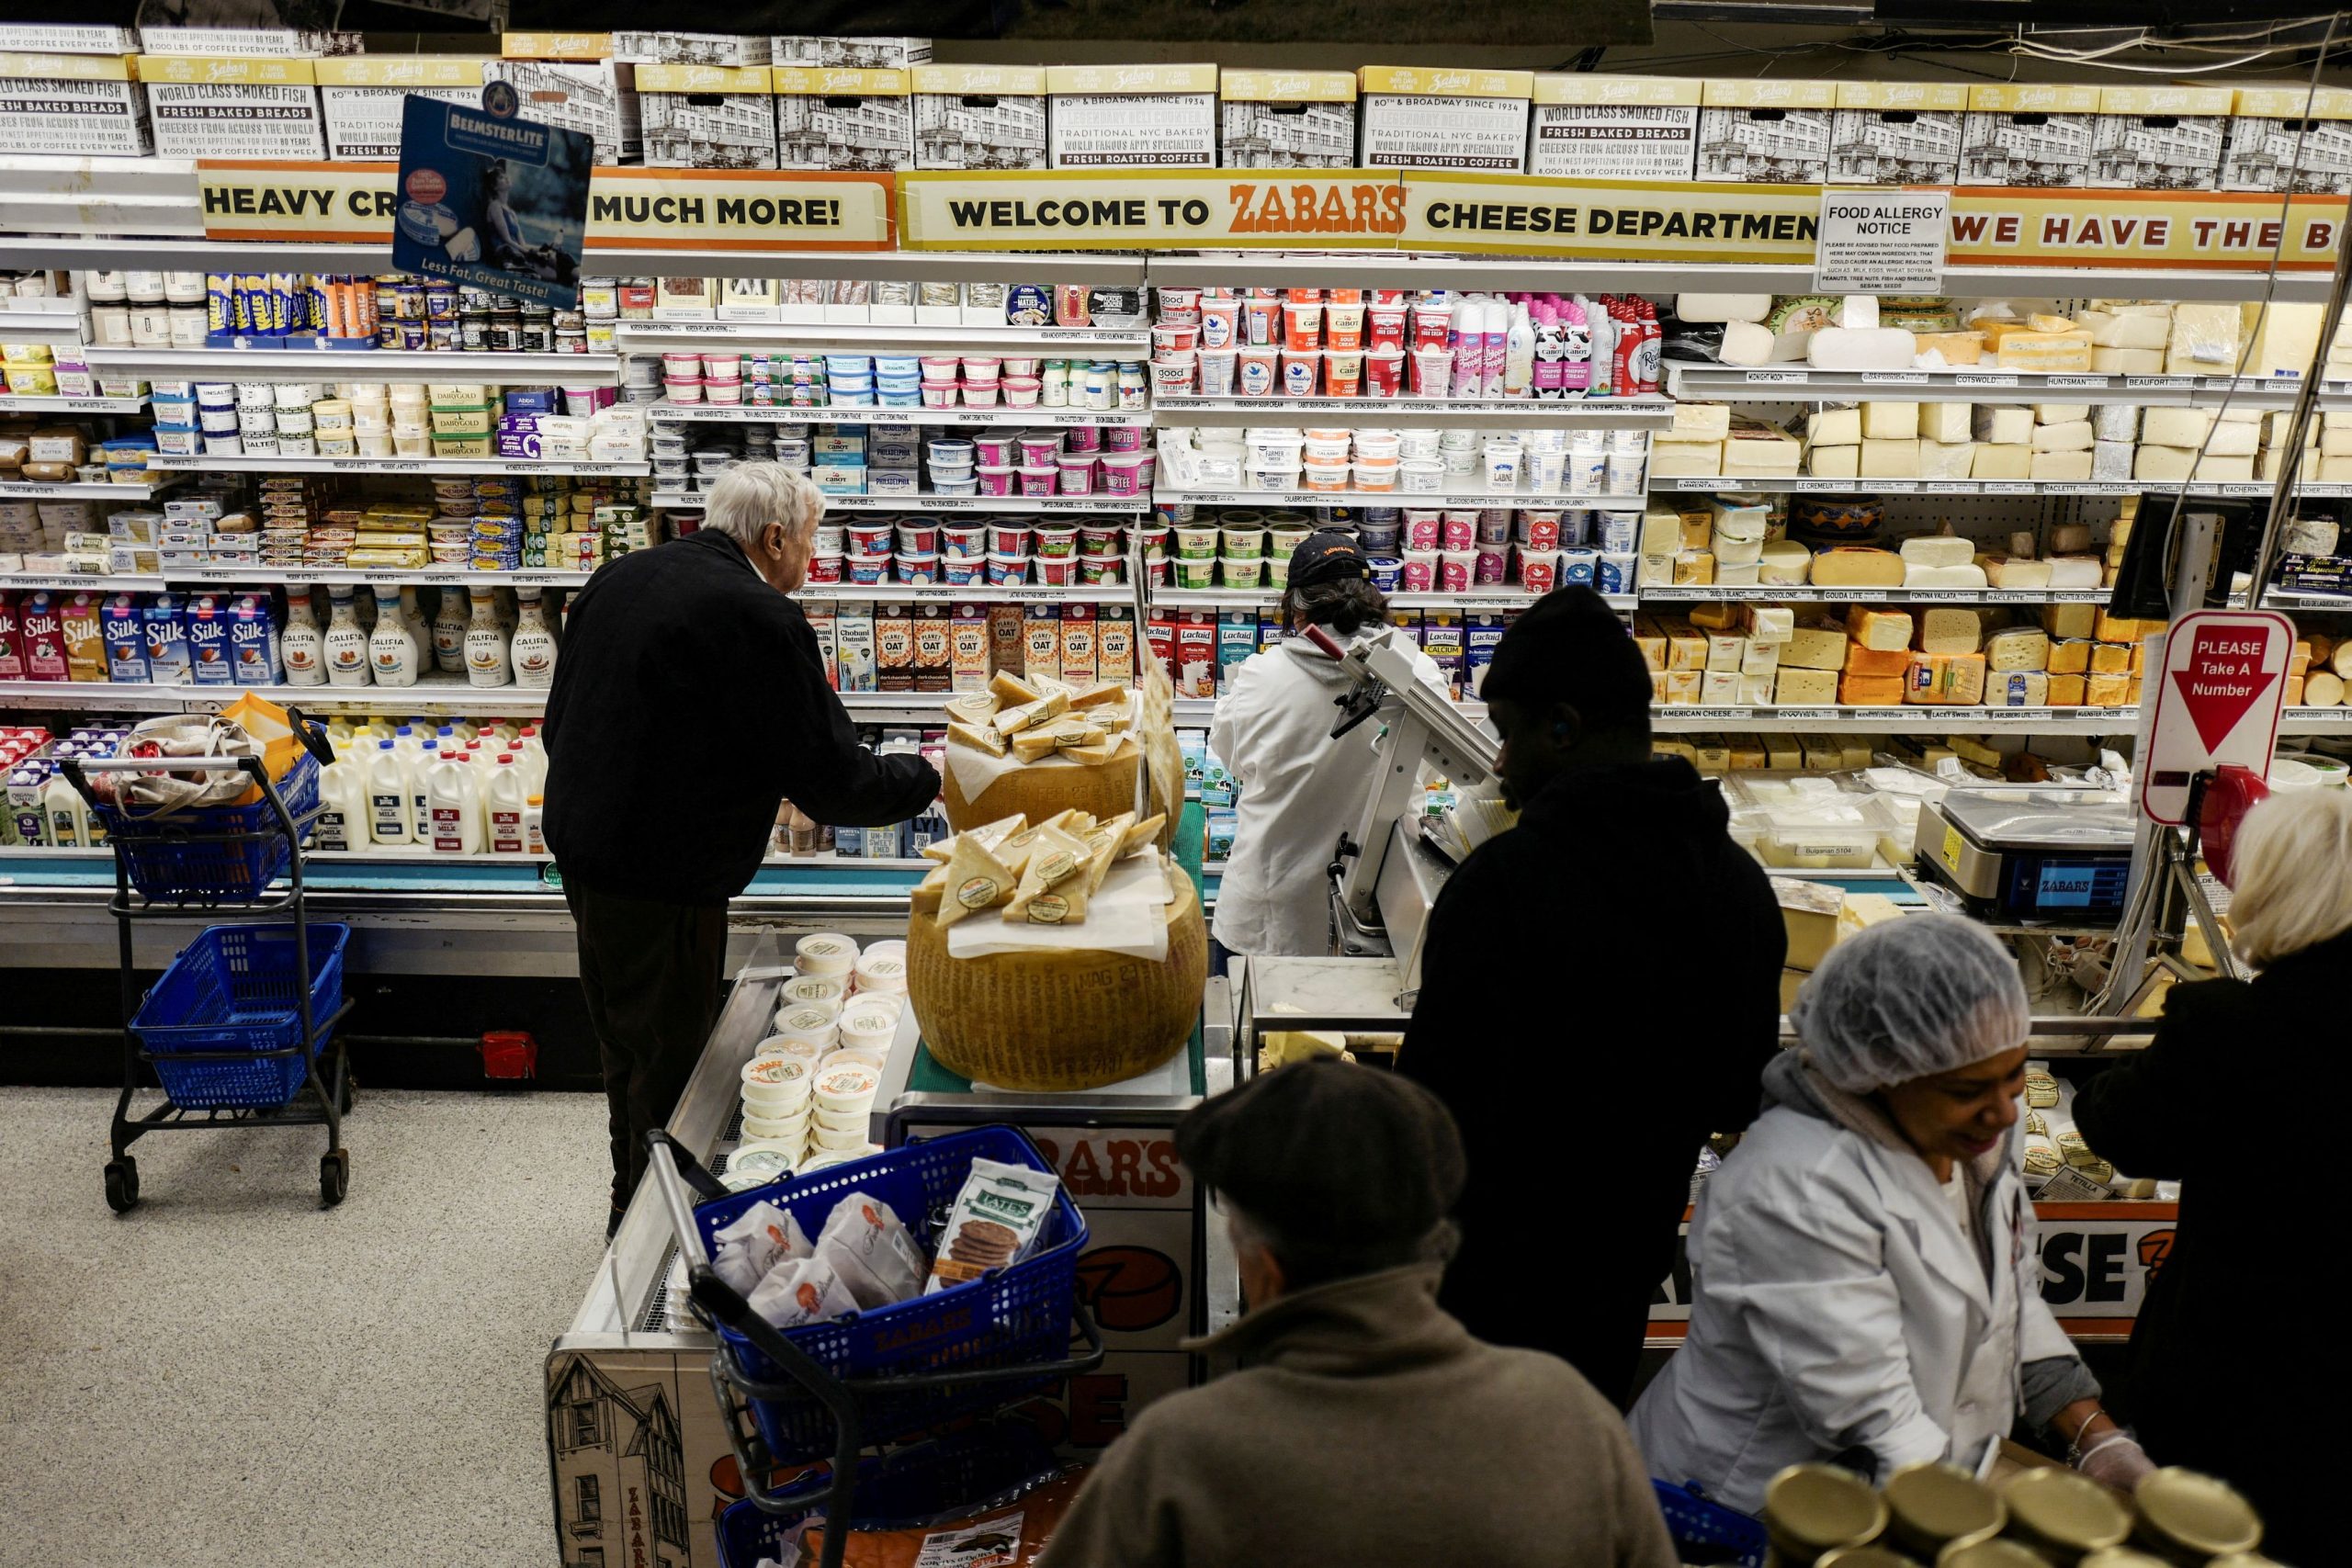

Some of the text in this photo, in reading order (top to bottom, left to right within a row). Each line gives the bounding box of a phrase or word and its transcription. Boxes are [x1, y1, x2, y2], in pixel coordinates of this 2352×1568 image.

[1091, 96, 1148, 105] BROADWAY
[1184, 97, 1205, 106] 1934
[1544, 107, 1690, 124] WORLD CLASS SMOKED FISH
[450, 114, 545, 148] BEEMSTERLITE
[1058, 130, 1135, 138] TRADITIONAL
[1166, 129, 1210, 137] BAKERY
[1546, 129, 1685, 139] FRESH BAKED BREADS
[1064, 140, 1204, 151] WORLD FAMOUS APPY SPECIALTIES
[1539, 143, 1690, 155] CHEESES FROM ACROSS THE WORLD
[1067, 153, 1204, 164] FRESH ROASTED COFFEE
[204, 187, 334, 217] HEAVY
[595, 196, 840, 226] MUCH MORE!
[949, 185, 1818, 242] WELCOME TO ZABAR'S CHEESE DEPARTMEN
[1828, 207, 1943, 220] FOOD ALLERGY
[1857, 222, 1911, 235] NOTICE
[1951, 216, 2019, 244] WE
[2043, 219, 2166, 247] HAVE
[2194, 221, 2281, 248] THE
[422, 258, 548, 299] Less Fat, Great Taste!
[1018, 298, 1039, 307] MATJES
[209, 295, 224, 330] KALLES
[1336, 319, 1359, 327] CABOT
[1158, 367, 1183, 378] good
[1747, 373, 1784, 381] MIDNIGHT MOON
[1957, 376, 1996, 384] COTSWOLD
[2129, 378, 2169, 387] BEAUFORT
[437, 392, 476, 400] DAIRYGOLD
[440, 419, 480, 427] DAIRYGOLD
[876, 448, 910, 457] PHILADELPHIA
[1493, 471, 1513, 482] LABNE
[1023, 482, 1047, 492] TEMPTEE
[2044, 484, 2077, 492] RACLETTE
[1825, 592, 1848, 600] GOUDA
[25, 616, 60, 637] Silk
[63, 618, 103, 645] Silk
[189, 621, 226, 642] Silk
[840, 628, 869, 637] Chobani
[1147, 627, 1172, 639] actaid
[1182, 628, 1214, 640] Lactaid
[1429, 632, 1459, 642] Lactaid
[283, 634, 315, 643] CALIFIA
[886, 641, 903, 651] OAT
[1107, 641, 1125, 651] OAT
[1428, 646, 1459, 655] CALCIUM
[2198, 640, 2261, 656] PLEASE
[2201, 662, 2251, 676] Take A
[2192, 682, 2252, 697] Number
[1662, 710, 1702, 718] AMERICAN
[1932, 710, 1950, 718] LACEY
[1994, 711, 2020, 719] JARLSBERG
[1805, 846, 1833, 855] Bulgarian
[2070, 1175, 2098, 1194] TETILLA
